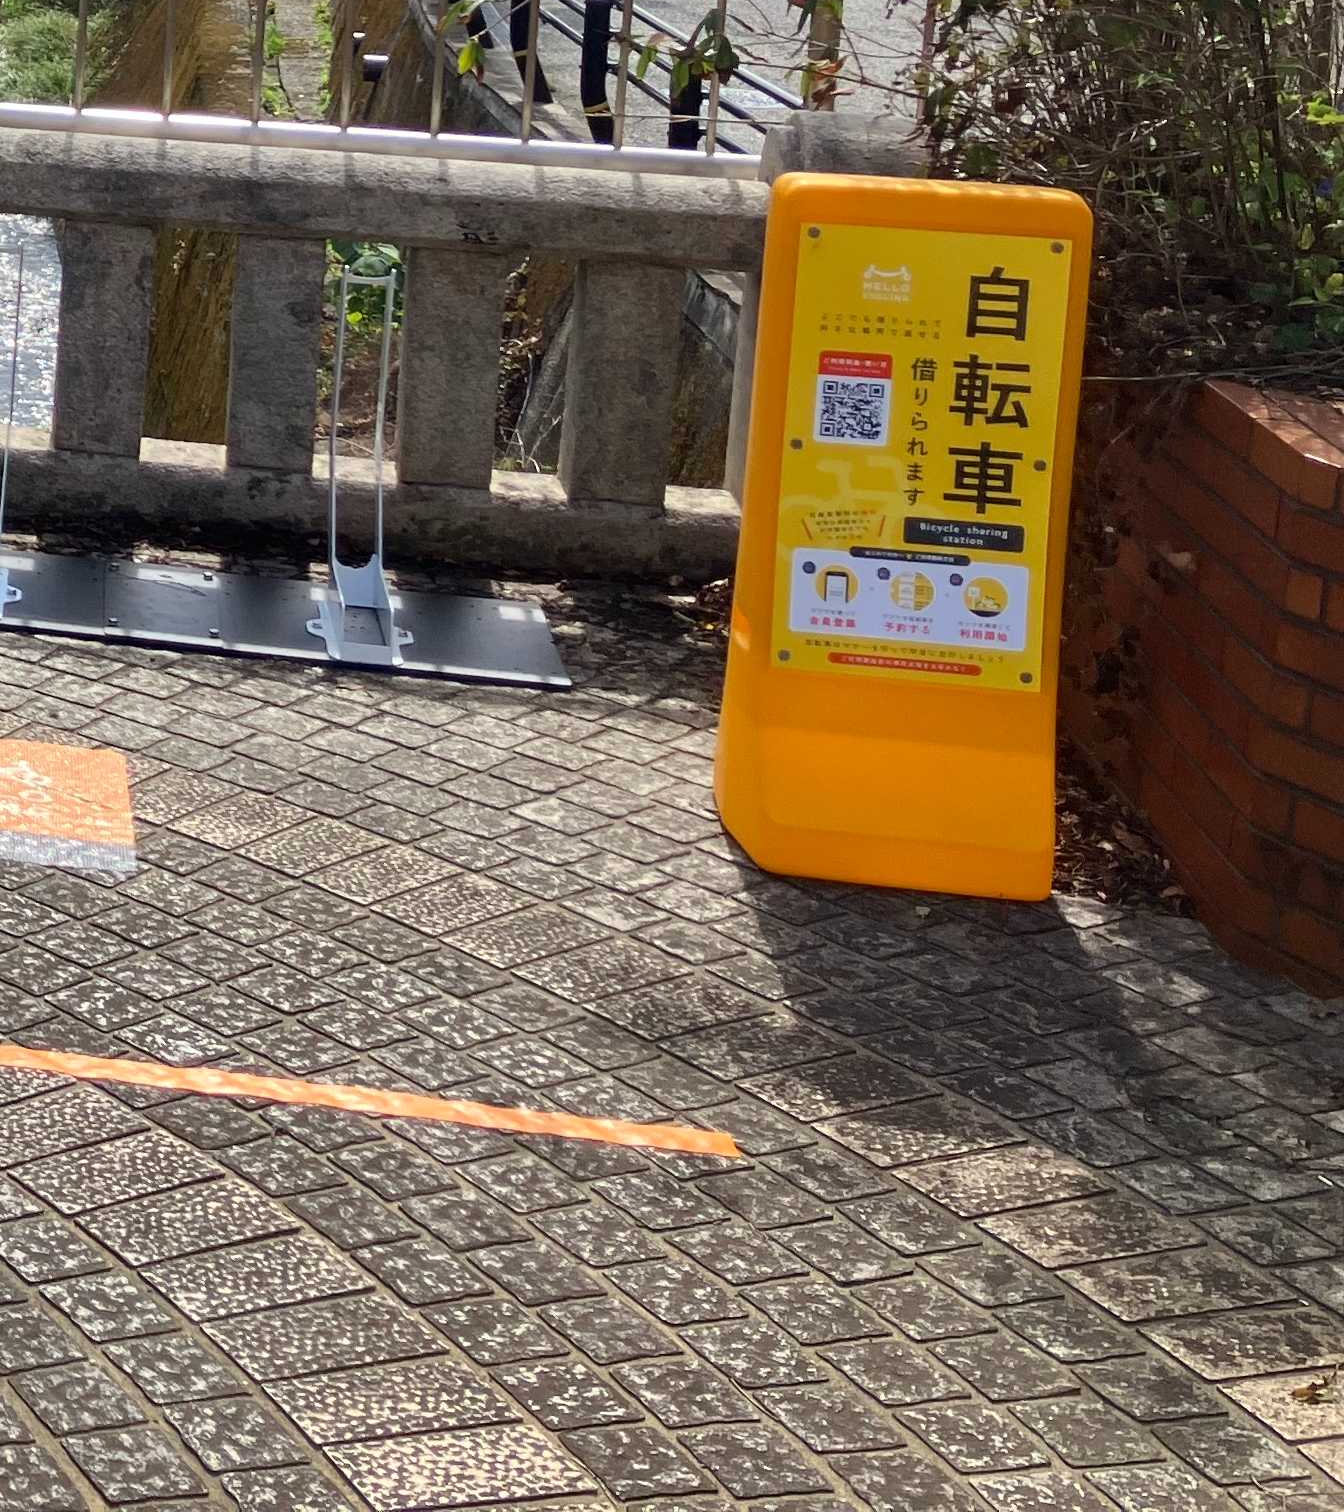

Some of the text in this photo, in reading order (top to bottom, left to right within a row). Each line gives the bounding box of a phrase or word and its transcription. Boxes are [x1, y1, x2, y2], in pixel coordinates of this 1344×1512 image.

[904, 357, 937, 506] 借りられます
[943, 266, 1032, 515] 自転車
[919, 521, 1009, 540] Bicycle sharing
[943, 535, 984, 546] station
